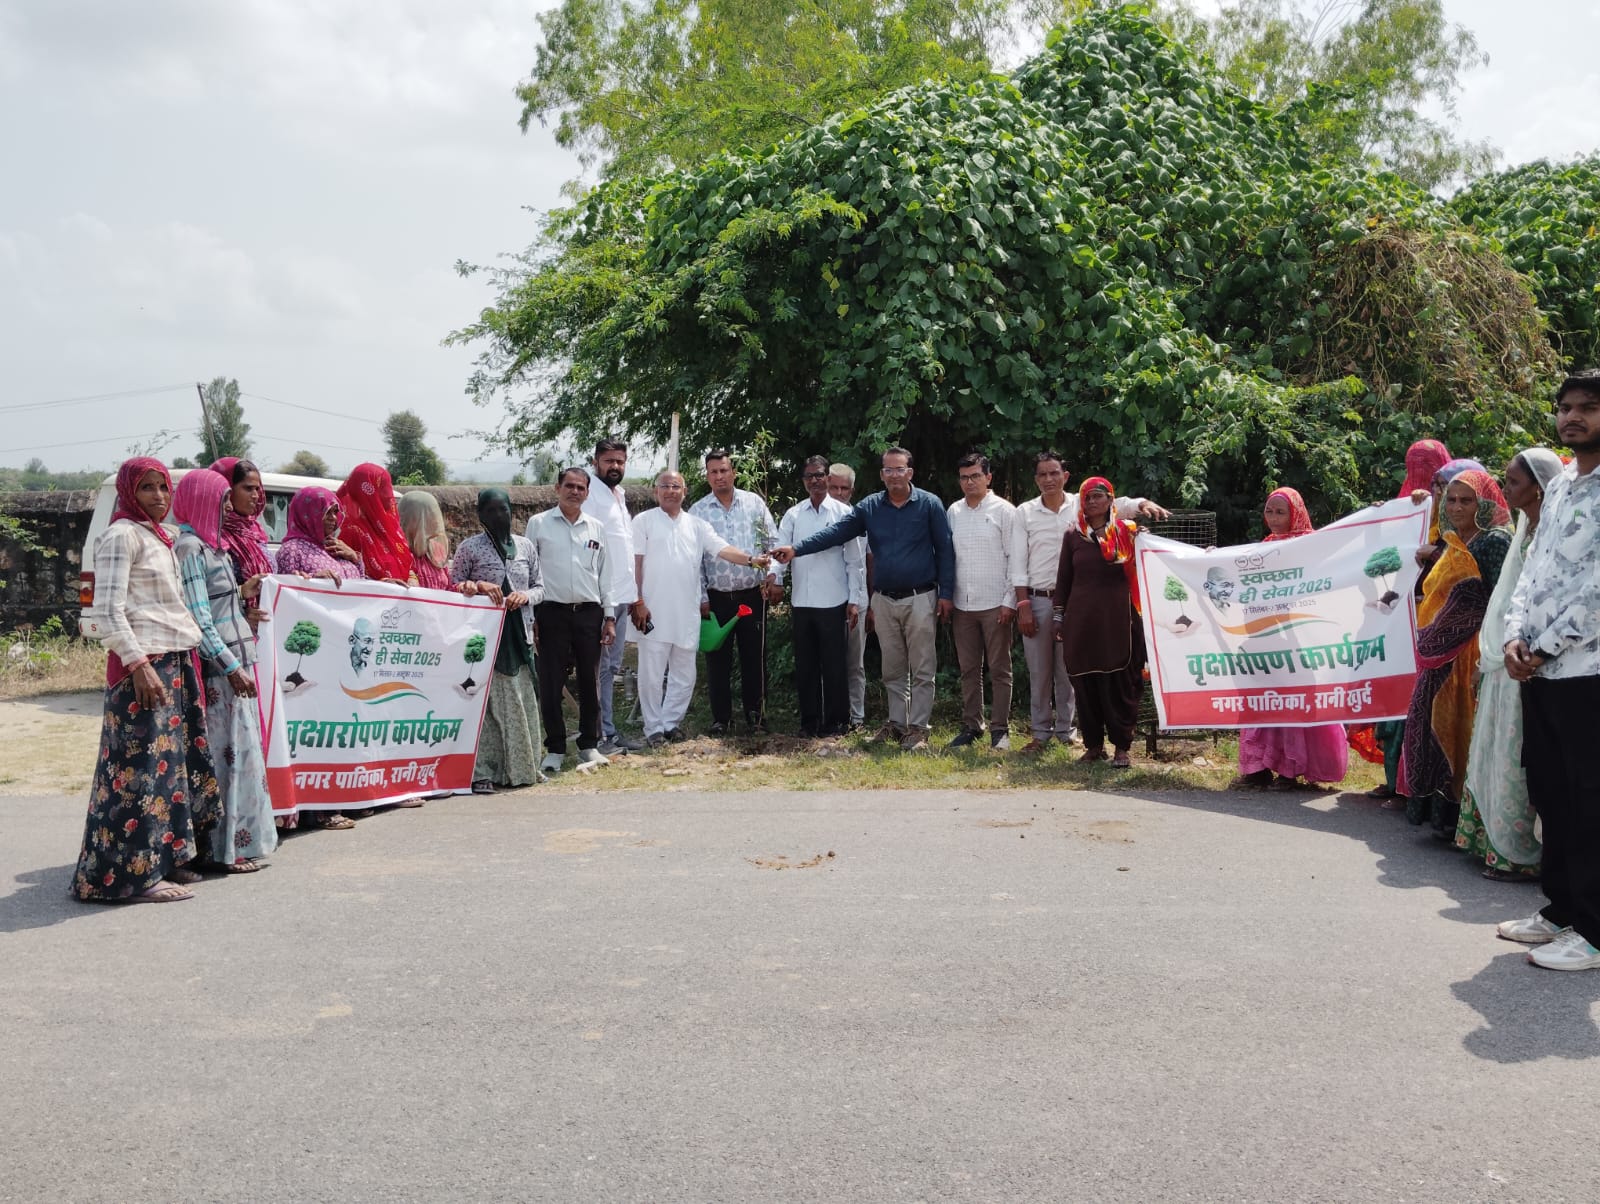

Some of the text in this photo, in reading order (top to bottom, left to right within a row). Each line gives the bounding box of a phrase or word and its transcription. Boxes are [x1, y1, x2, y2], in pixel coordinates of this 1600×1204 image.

[1239, 567, 1304, 586] स्वच्छता
[1239, 577, 1333, 604] ही सेवा 2025
[379, 632, 423, 646] स्वच्छता
[375, 646, 442, 666] ही सेवा 2025
[1185, 632, 1386, 686] वृक्षारोपण कार्यक्रम
[1211, 681, 1373, 713] नगर पालिका, रानी खुर्द
[286, 710, 464, 758] वृक्षारोपण कार्यक्रम
[295, 758, 440, 789] नगर पालिका, रानी खुर्द
